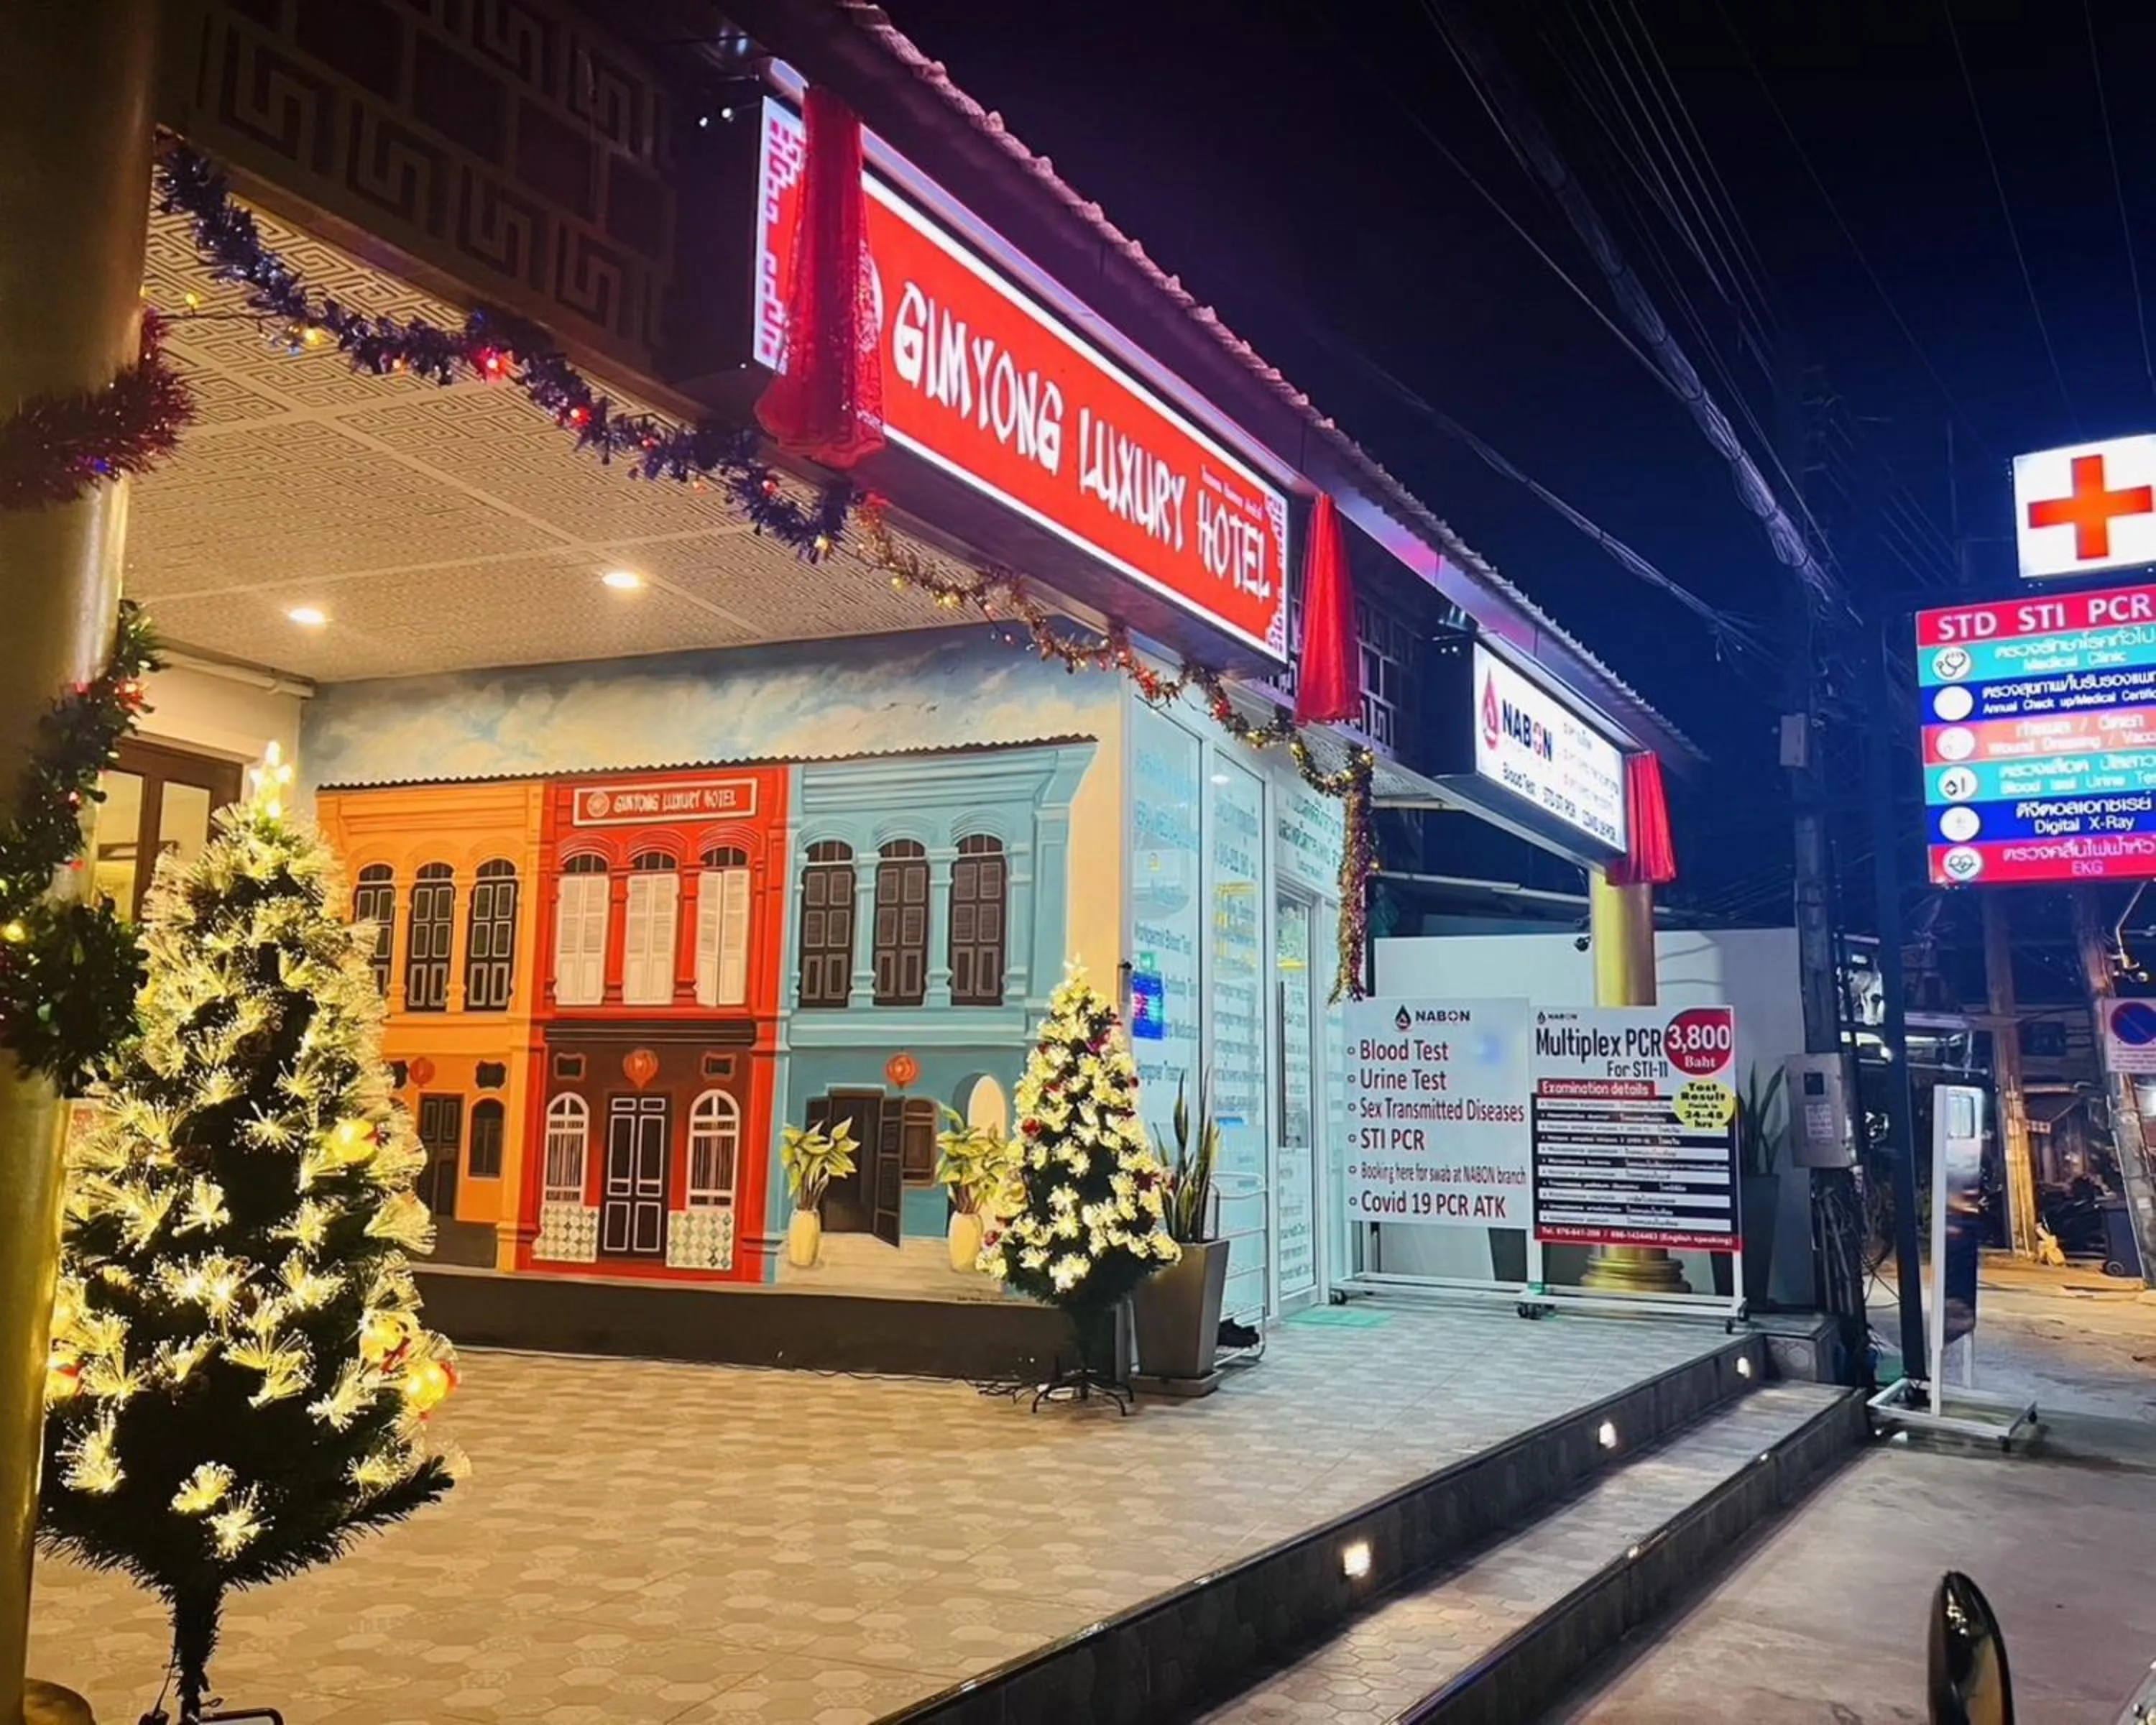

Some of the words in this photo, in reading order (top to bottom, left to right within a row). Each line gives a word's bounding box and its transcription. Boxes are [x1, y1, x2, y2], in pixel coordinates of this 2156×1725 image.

[893, 281, 1064, 477] GIMYONG
[1079, 406, 1187, 553] LUXURY
[1196, 489, 1271, 604] HOTEL
[1938, 611, 1997, 640] STD
[2018, 602, 2066, 632] STI
[2088, 593, 2153, 624] PCR
[2087, 650, 2127, 666] Clinic
[1502, 697, 1553, 763] NABON
[2034, 818, 2080, 835] Digital
[2088, 814, 2135, 832] X-Ray
[2071, 860, 2104, 875] EKG
[1415, 1010, 1470, 1022] NABON
[1360, 1039, 1409, 1061] Blood
[1414, 1039, 1449, 1062] Test
[1536, 1028, 1621, 1064] Multiplex
[1625, 1028, 1663, 1058] PCR
[1667, 1024, 1731, 1054] 3,800
[1606, 1061, 1631, 1078] For
[1633, 1061, 1669, 1078] STI-11
[1684, 1057, 1716, 1069] Baht
[1360, 1067, 1407, 1090] Urine
[1411, 1069, 1447, 1090] Test
[1542, 1080, 1611, 1095] Examination
[1611, 1082, 1649, 1097] details
[1687, 1082, 1718, 1092] Test
[1680, 1092, 1726, 1101] Result
[1360, 1096, 1382, 1118] Sex
[1385, 1097, 1463, 1121] Transmitted
[1467, 1098, 1524, 1123] Diseases
[1360, 1127, 1386, 1149] STI
[1391, 1128, 1425, 1151] PCR
[1361, 1161, 1394, 1185] Booking
[1396, 1162, 1414, 1182] here
[1415, 1162, 1429, 1182] for
[1429, 1164, 1452, 1183] swab
[1452, 1165, 1462, 1184] at
[1462, 1164, 1496, 1184] NABON
[1497, 1166, 1527, 1185] branch
[1360, 1190, 1406, 1213] Covid
[1411, 1192, 1432, 1215] 19
[1436, 1193, 1469, 1217] PCR
[1473, 1195, 1506, 1218] ATK
